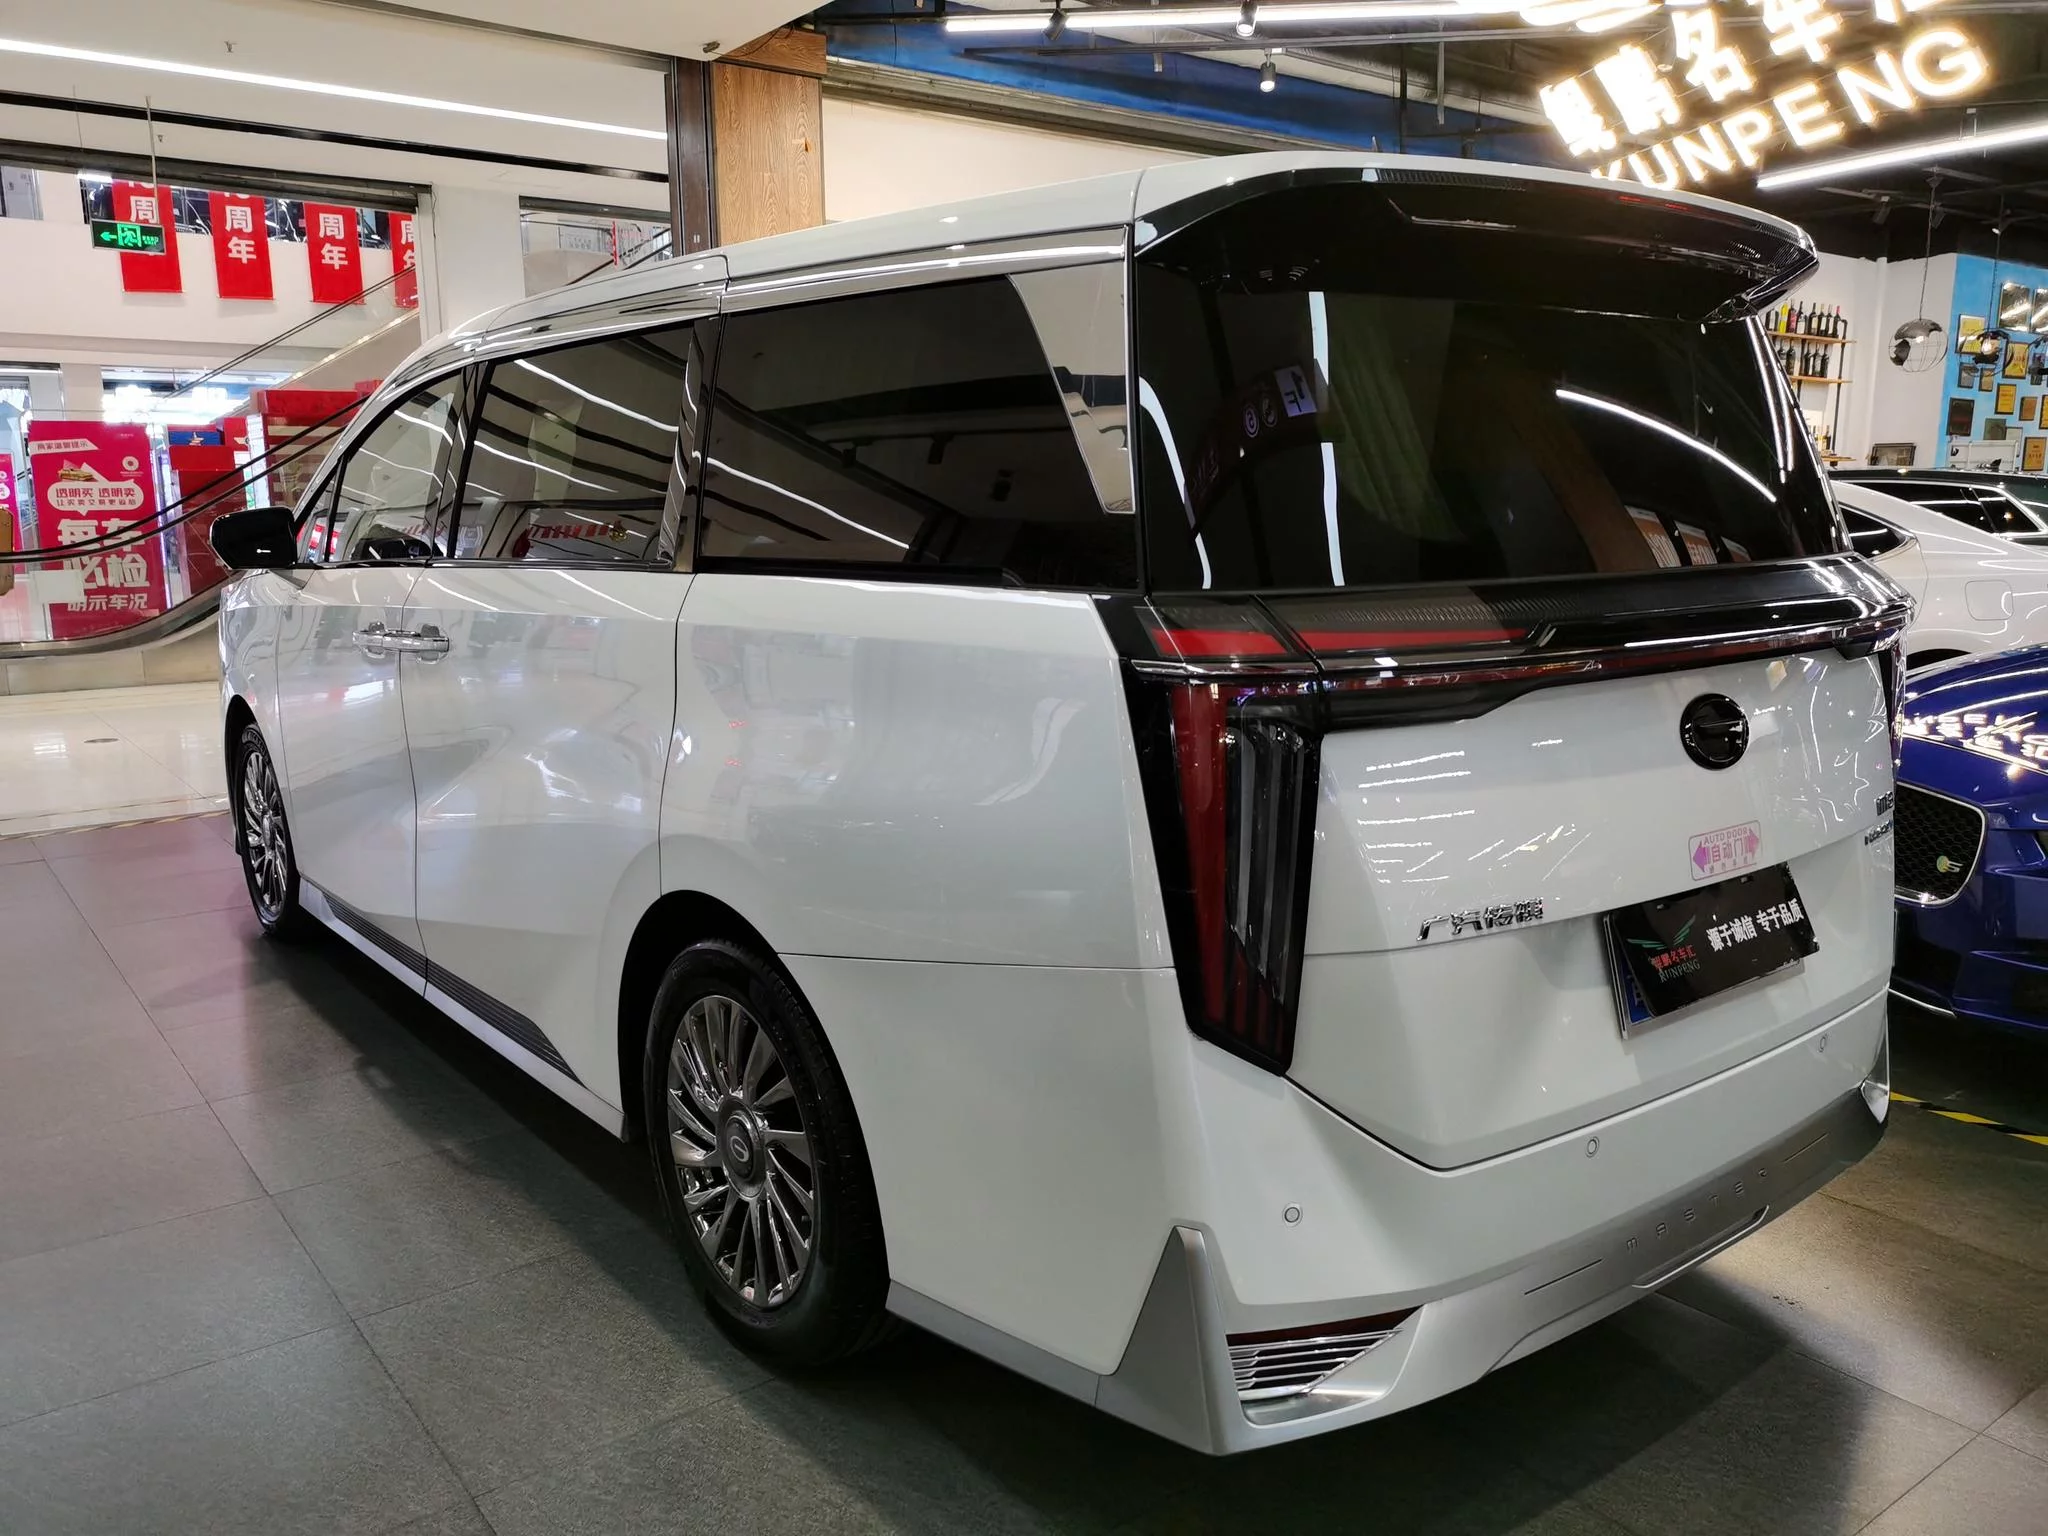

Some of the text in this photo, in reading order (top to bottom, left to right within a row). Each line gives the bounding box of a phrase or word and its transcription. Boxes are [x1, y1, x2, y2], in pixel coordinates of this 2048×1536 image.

[224, 192, 258, 264] 周年
[318, 212, 349, 270] 周年
[57, 518, 145, 553] 每车
[1704, 831, 1725, 845] AUTO
[1711, 837, 1743, 863] 自动门
[1417, 898, 1543, 940] 广汽传祺
[1706, 897, 1805, 952] 源于诚信 专于品质
